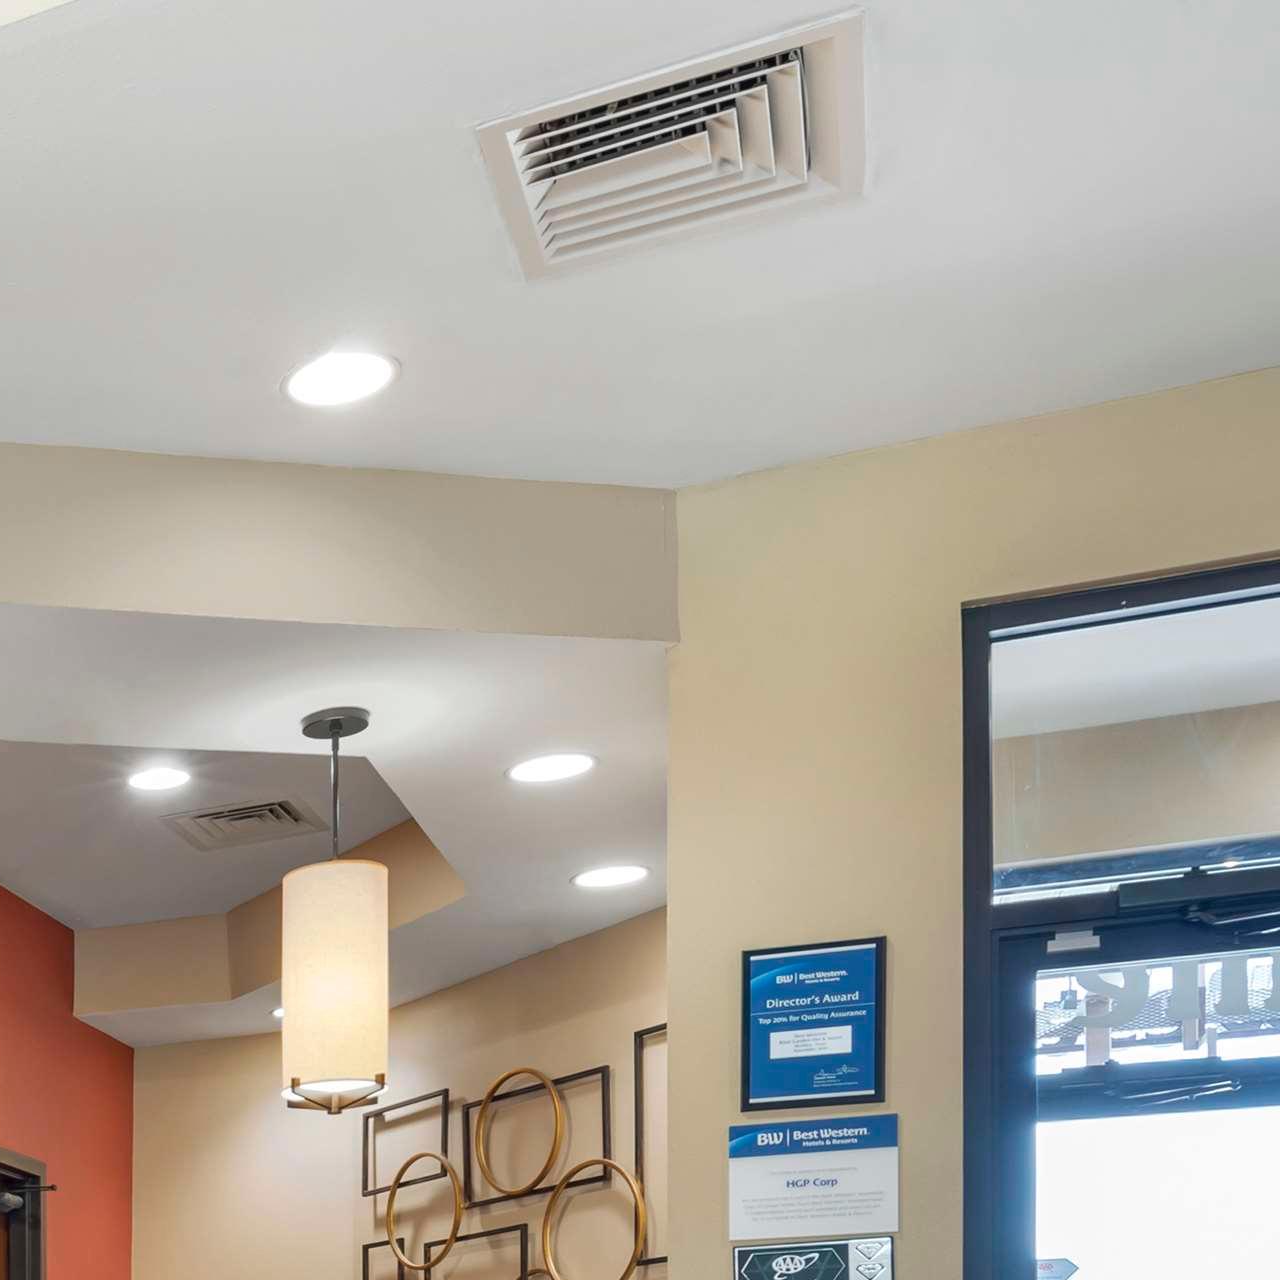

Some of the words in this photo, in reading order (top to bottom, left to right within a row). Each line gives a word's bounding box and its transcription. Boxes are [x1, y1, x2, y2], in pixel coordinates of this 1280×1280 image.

[766, 995, 820, 1009] Director's
[822, 991, 860, 1003] Award
[801, 1012, 829, 1021] Quality
[830, 1010, 867, 1018] Assurance
[756, 1132, 783, 1146] BW
[793, 1130, 818, 1140] Best
[819, 1127, 867, 1138] Western
[786, 1178, 810, 1189] HGP
[813, 1177, 838, 1188] Corp
